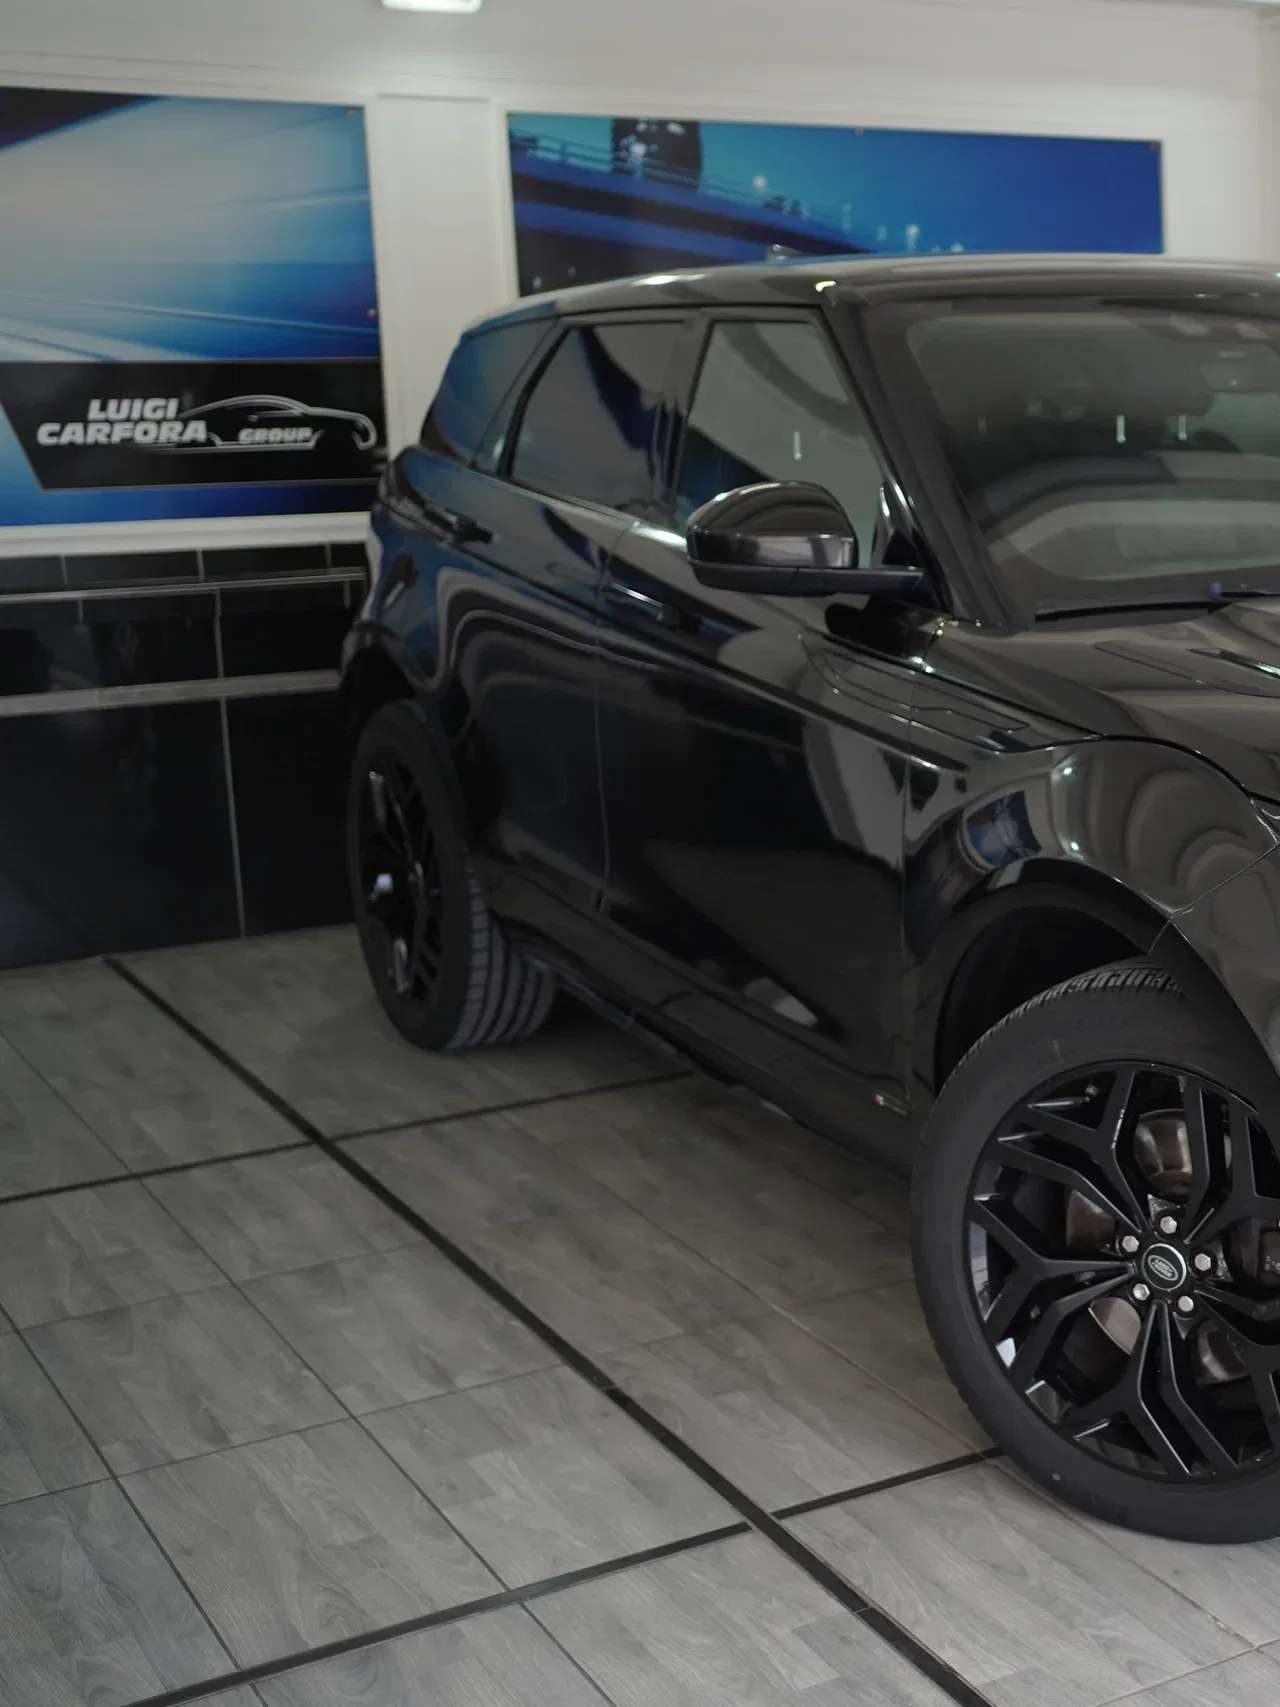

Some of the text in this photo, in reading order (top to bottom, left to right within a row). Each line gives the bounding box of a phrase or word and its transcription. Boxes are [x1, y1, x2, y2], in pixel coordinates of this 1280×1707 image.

[87, 398, 179, 421] LUIGI
[36, 420, 313, 446] CARFORA GROUP
